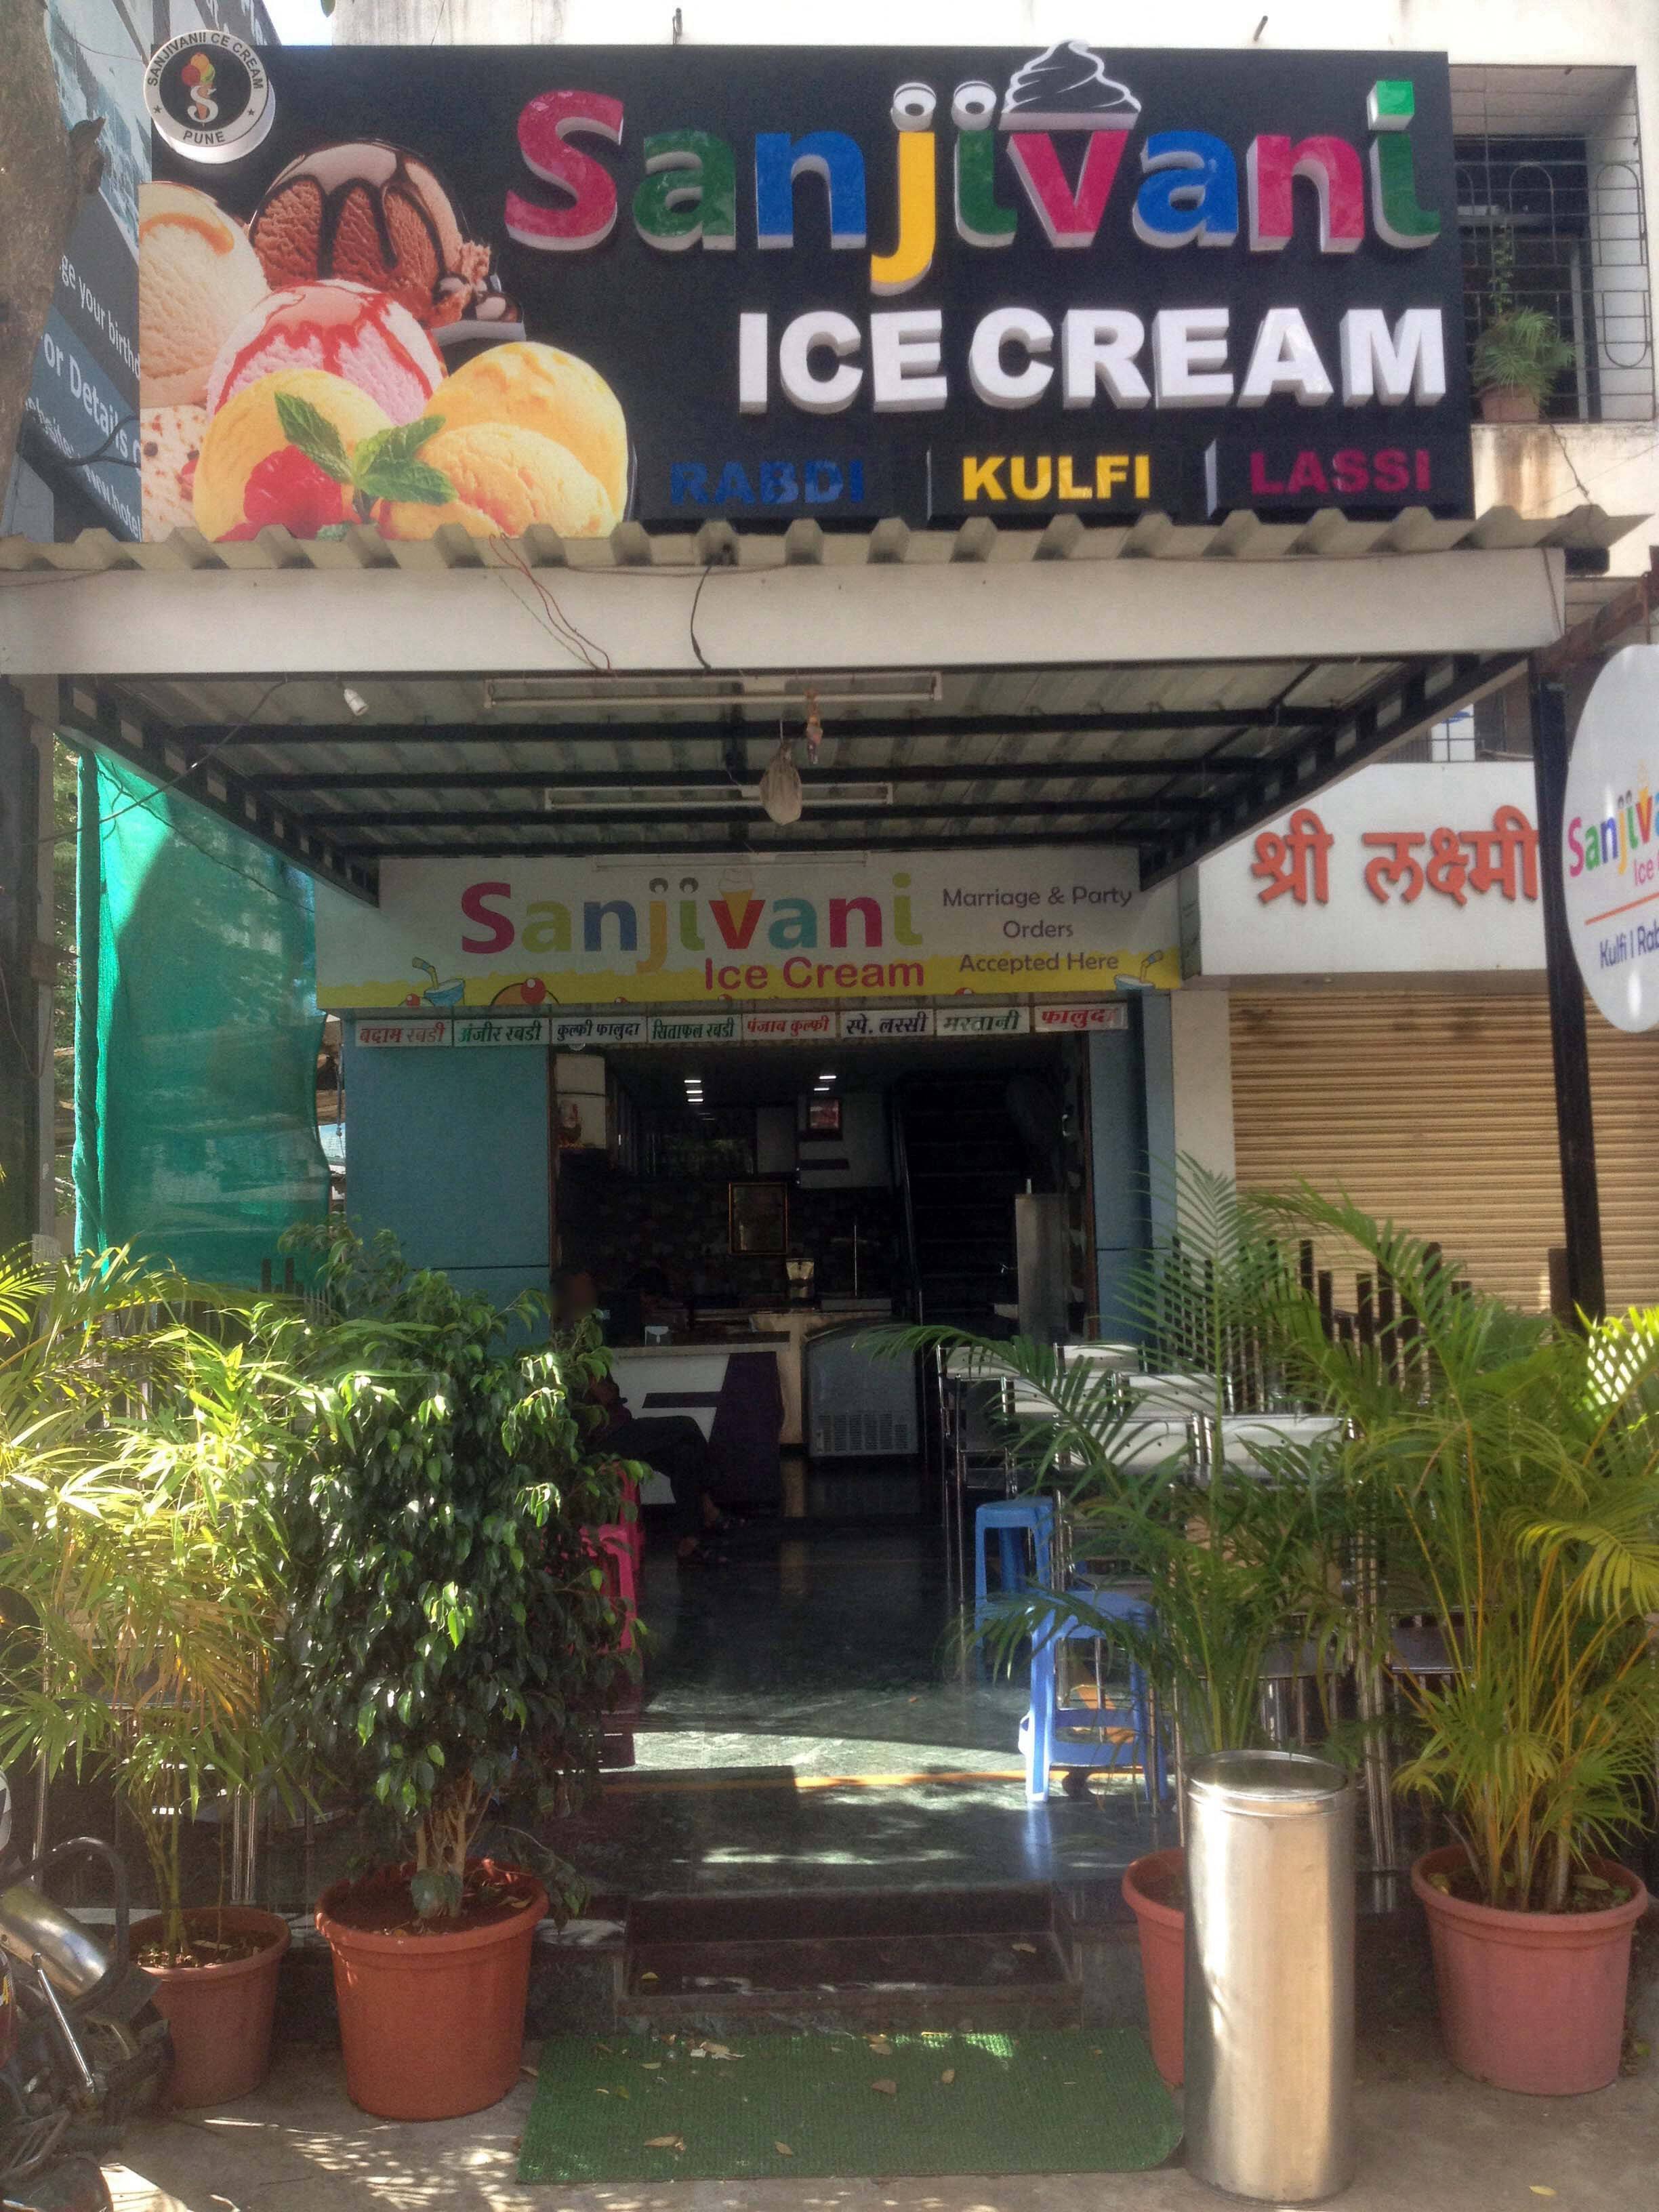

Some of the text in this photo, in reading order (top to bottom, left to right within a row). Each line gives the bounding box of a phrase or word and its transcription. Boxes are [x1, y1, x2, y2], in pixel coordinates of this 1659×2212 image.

[232, 43, 264, 89] CREAM
[183, 130, 226, 144] PUNE
[504, 79, 1441, 296] Sanjivani
[78, 276, 106, 331] your
[739, 307, 1447, 415] ICE CREAM
[670, 450, 1431, 506] RABDI KULFI LASSI
[1251, 805, 1538, 905] श्री लक्ष्मी
[1633, 859, 1654, 886] Ice
[943, 886, 1132, 908] Marriage & Party
[462, 873, 923, 974] Sanjivani
[1002, 919, 1074, 939] Orders
[959, 951, 1119, 974] Accepted Here
[1599, 933, 1626, 969] Kulfi
[705, 956, 924, 991] Ice Cream
